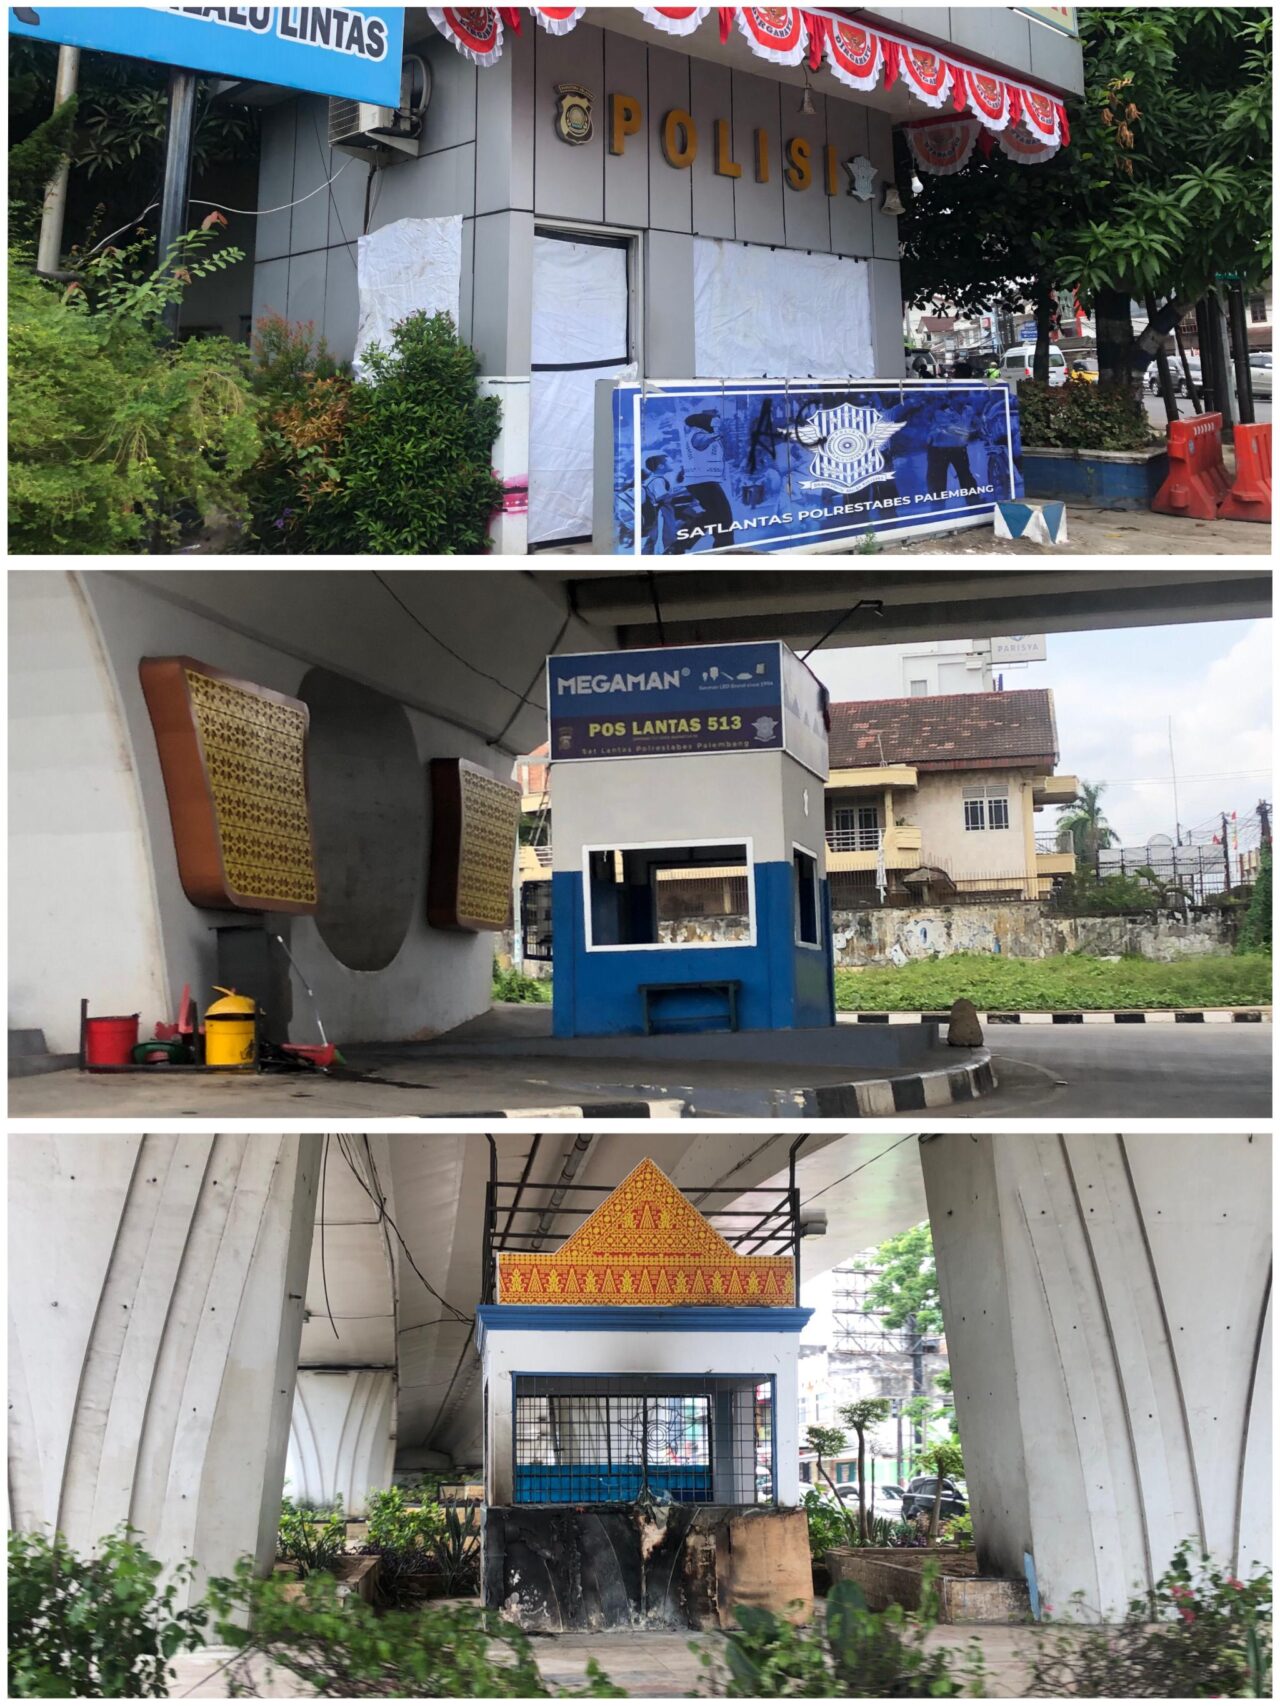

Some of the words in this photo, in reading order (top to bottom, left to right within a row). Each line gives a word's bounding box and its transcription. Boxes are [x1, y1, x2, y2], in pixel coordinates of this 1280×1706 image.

[281, 7, 385, 58] LINTAS
[609, 93, 839, 196] POLISI
[676, 512, 793, 541] SATLANTAS
[798, 495, 912, 521] POLRESTABES
[915, 484, 995, 506] PALEMBANG
[557, 669, 681, 696] MEGAMAN
[588, 722, 626, 738] POS
[632, 717, 701, 736] LANTAS
[707, 715, 742, 732] 513
